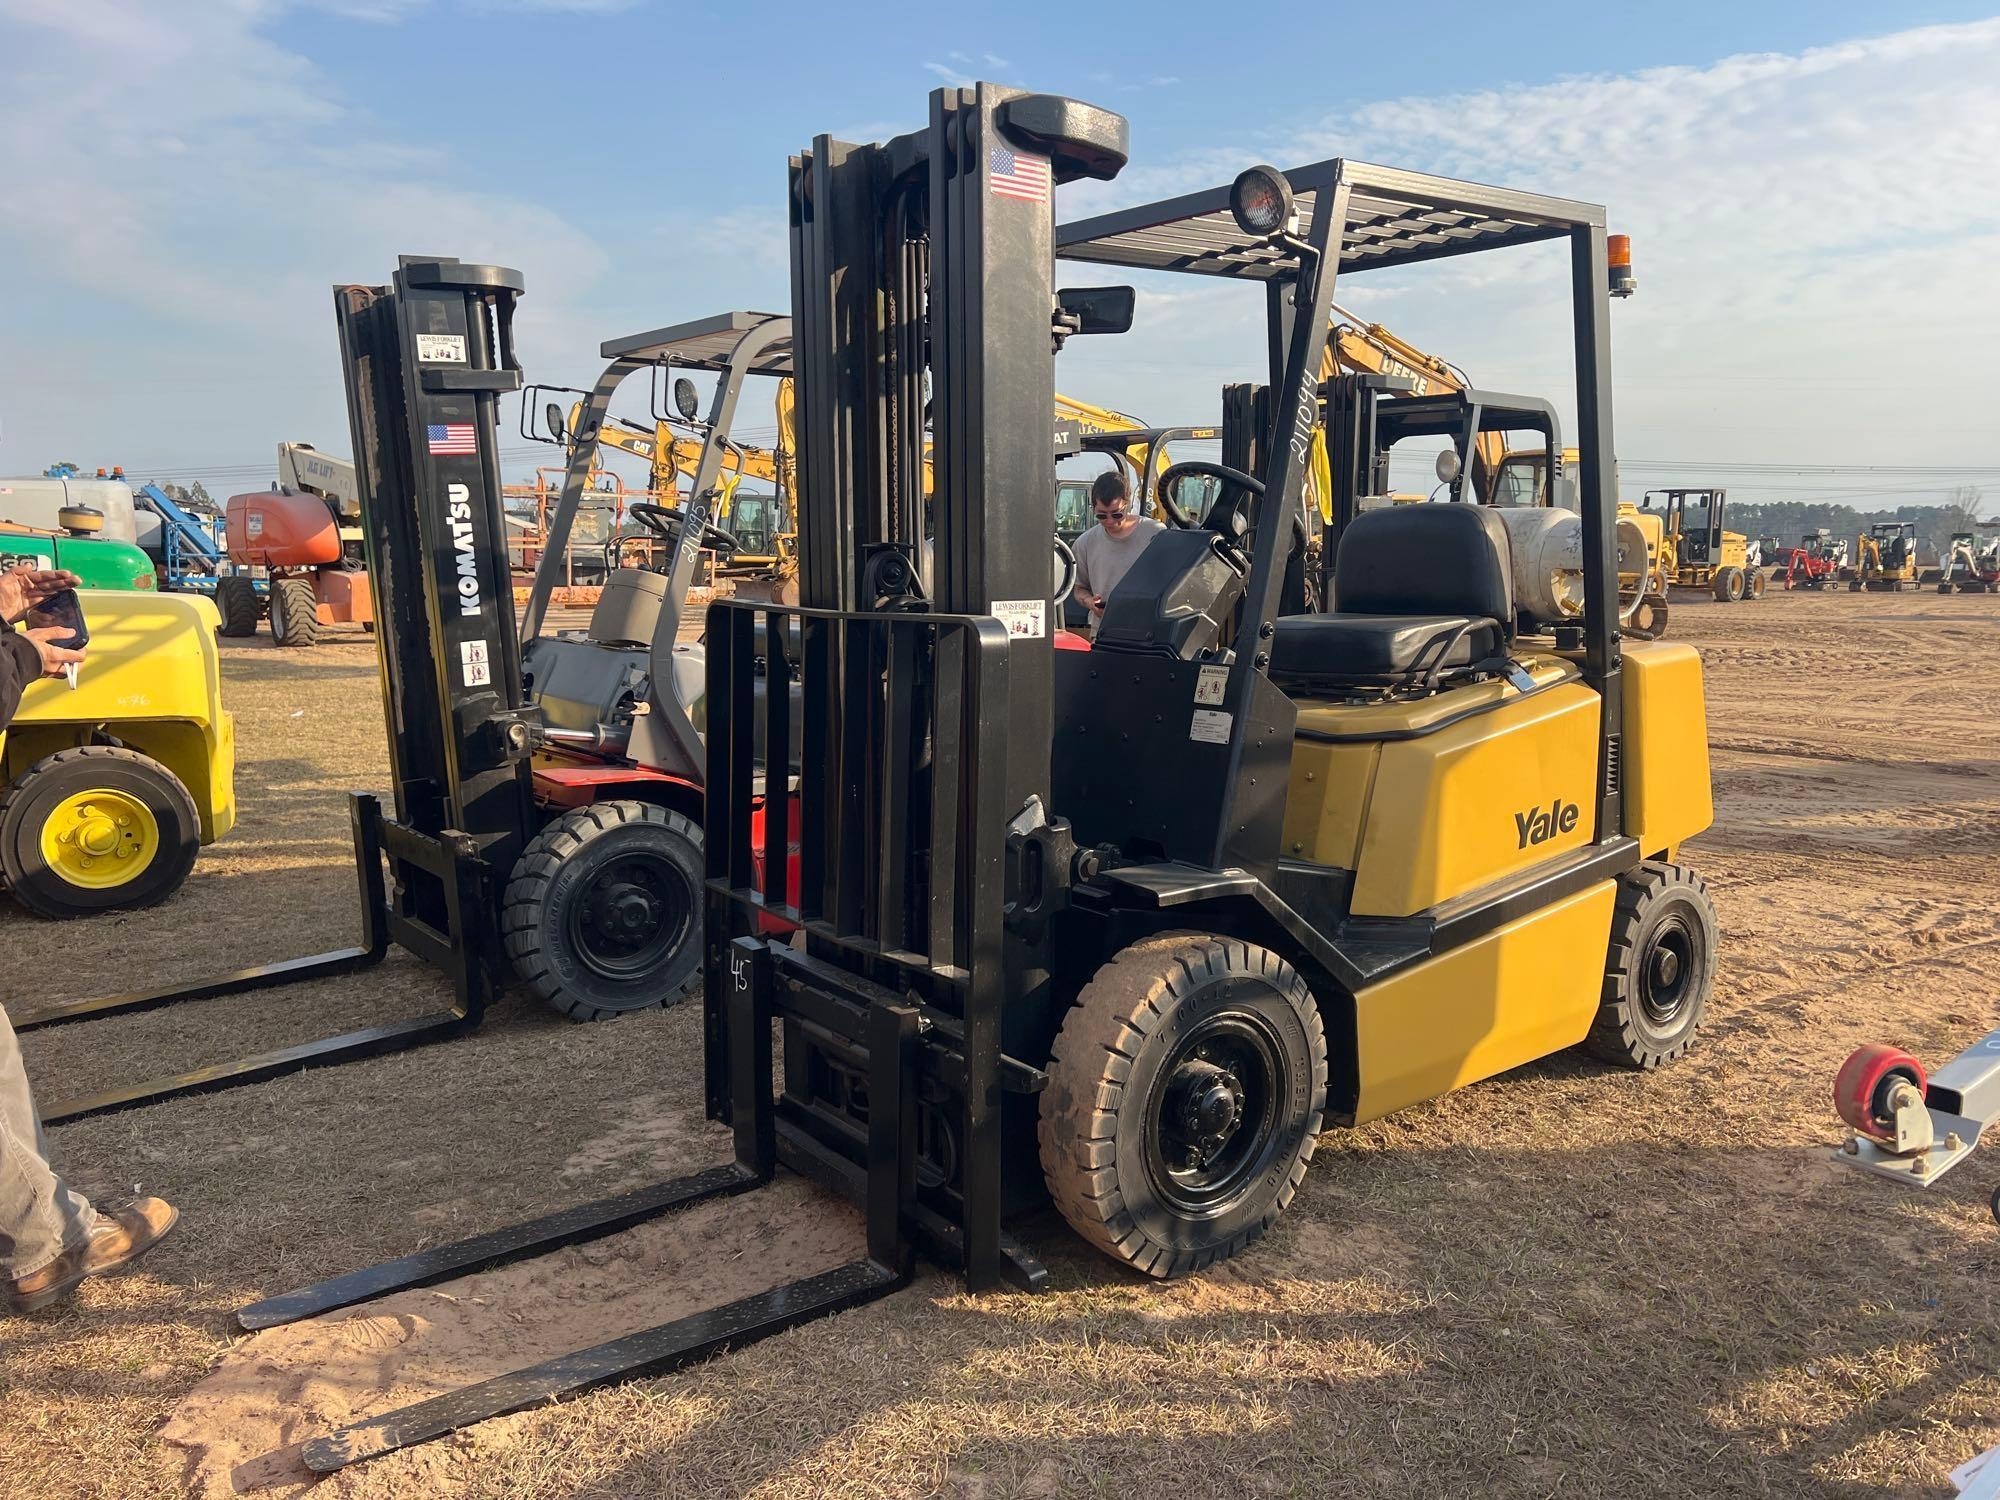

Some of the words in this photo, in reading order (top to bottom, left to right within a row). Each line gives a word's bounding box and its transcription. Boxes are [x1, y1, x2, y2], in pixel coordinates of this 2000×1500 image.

[1381, 355, 1428, 395] DEERE
[1289, 368, 1319, 464] 211094
[633, 440, 651, 454] CAT
[1054, 431, 1069, 445] AT
[306, 460, 318, 475] JLG
[319, 463, 333, 479] LIFT
[446, 483, 482, 616] KOMATSU
[681, 501, 706, 563] 211095
[995, 602, 1015, 610] LEWIS
[1015, 601, 1042, 610] FORKLIFT
[1206, 668, 1227, 676] WARNING
[1514, 798, 1579, 850] Yale
[730, 948, 752, 993] 45
